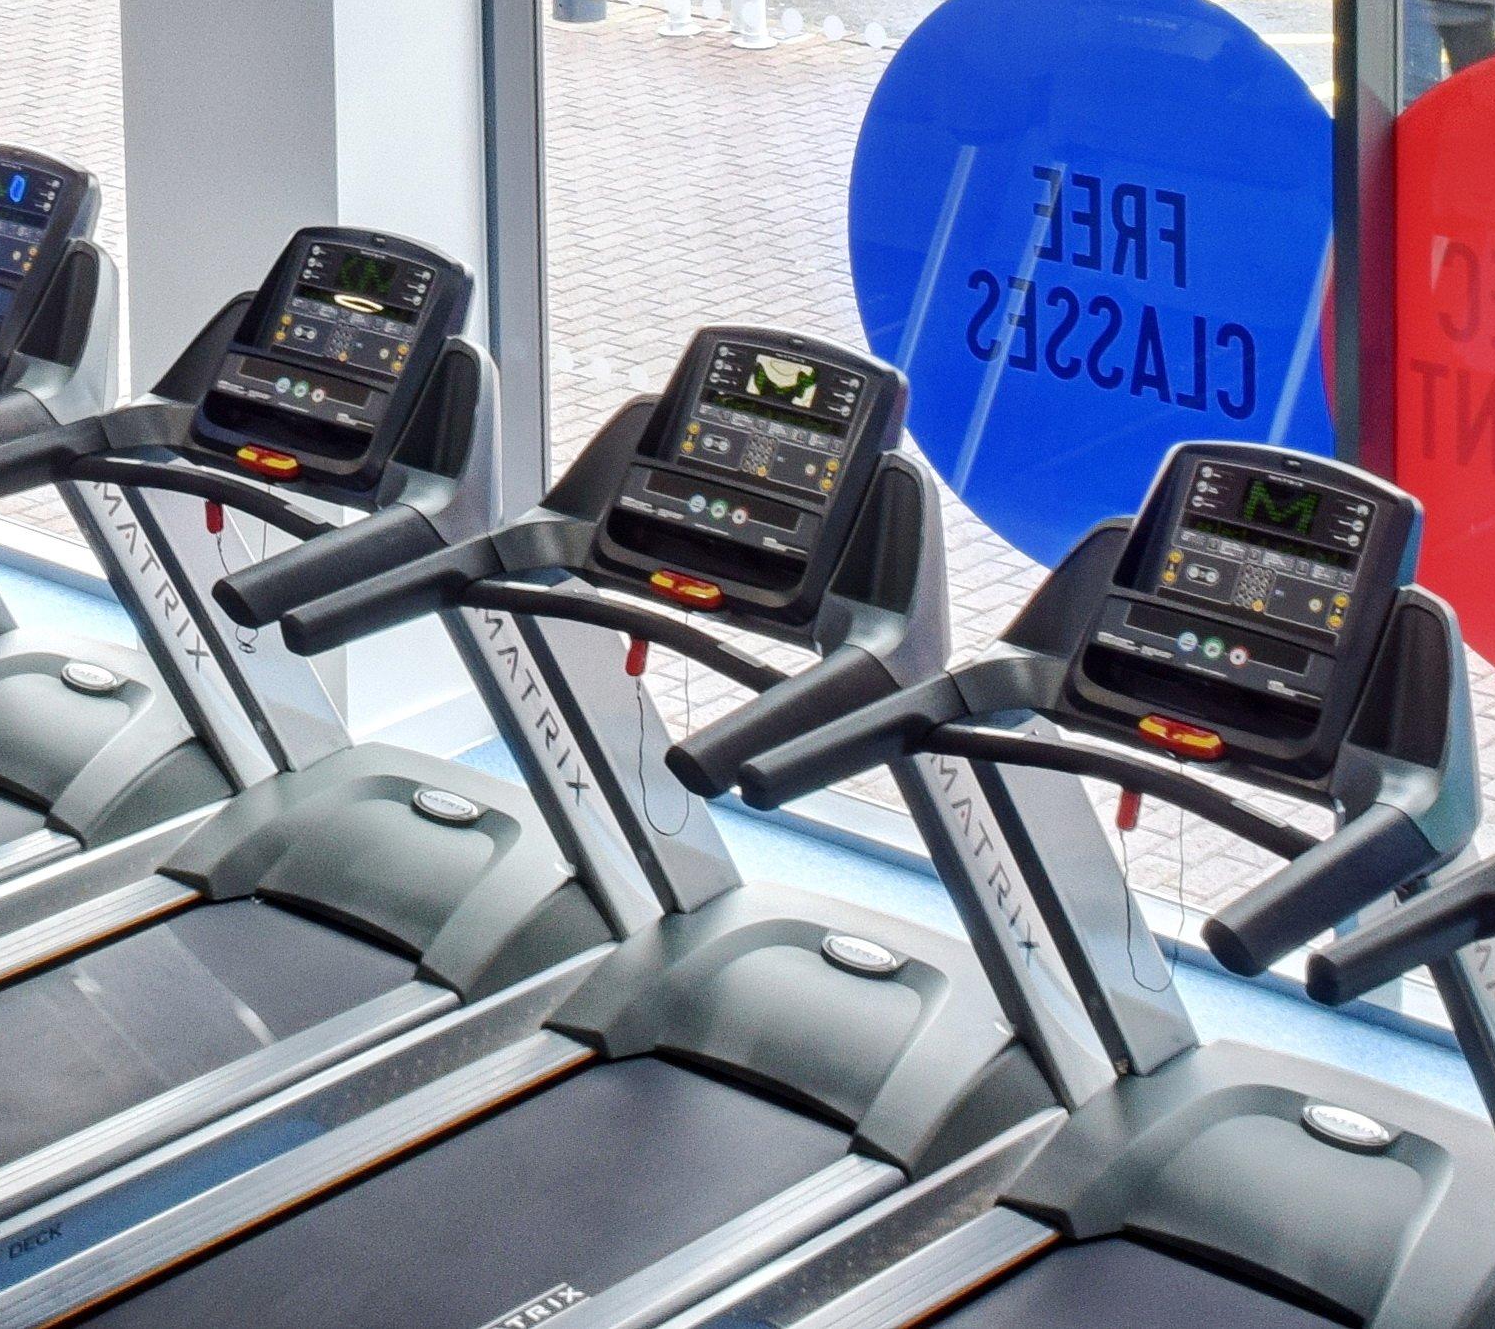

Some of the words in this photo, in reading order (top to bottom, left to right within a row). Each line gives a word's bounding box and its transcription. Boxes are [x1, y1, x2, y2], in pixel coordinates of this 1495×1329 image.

[94, 482, 210, 672] MATRIX
[7, 1224, 62, 1261] DECK
[504, 1286, 586, 1329] TRIX
